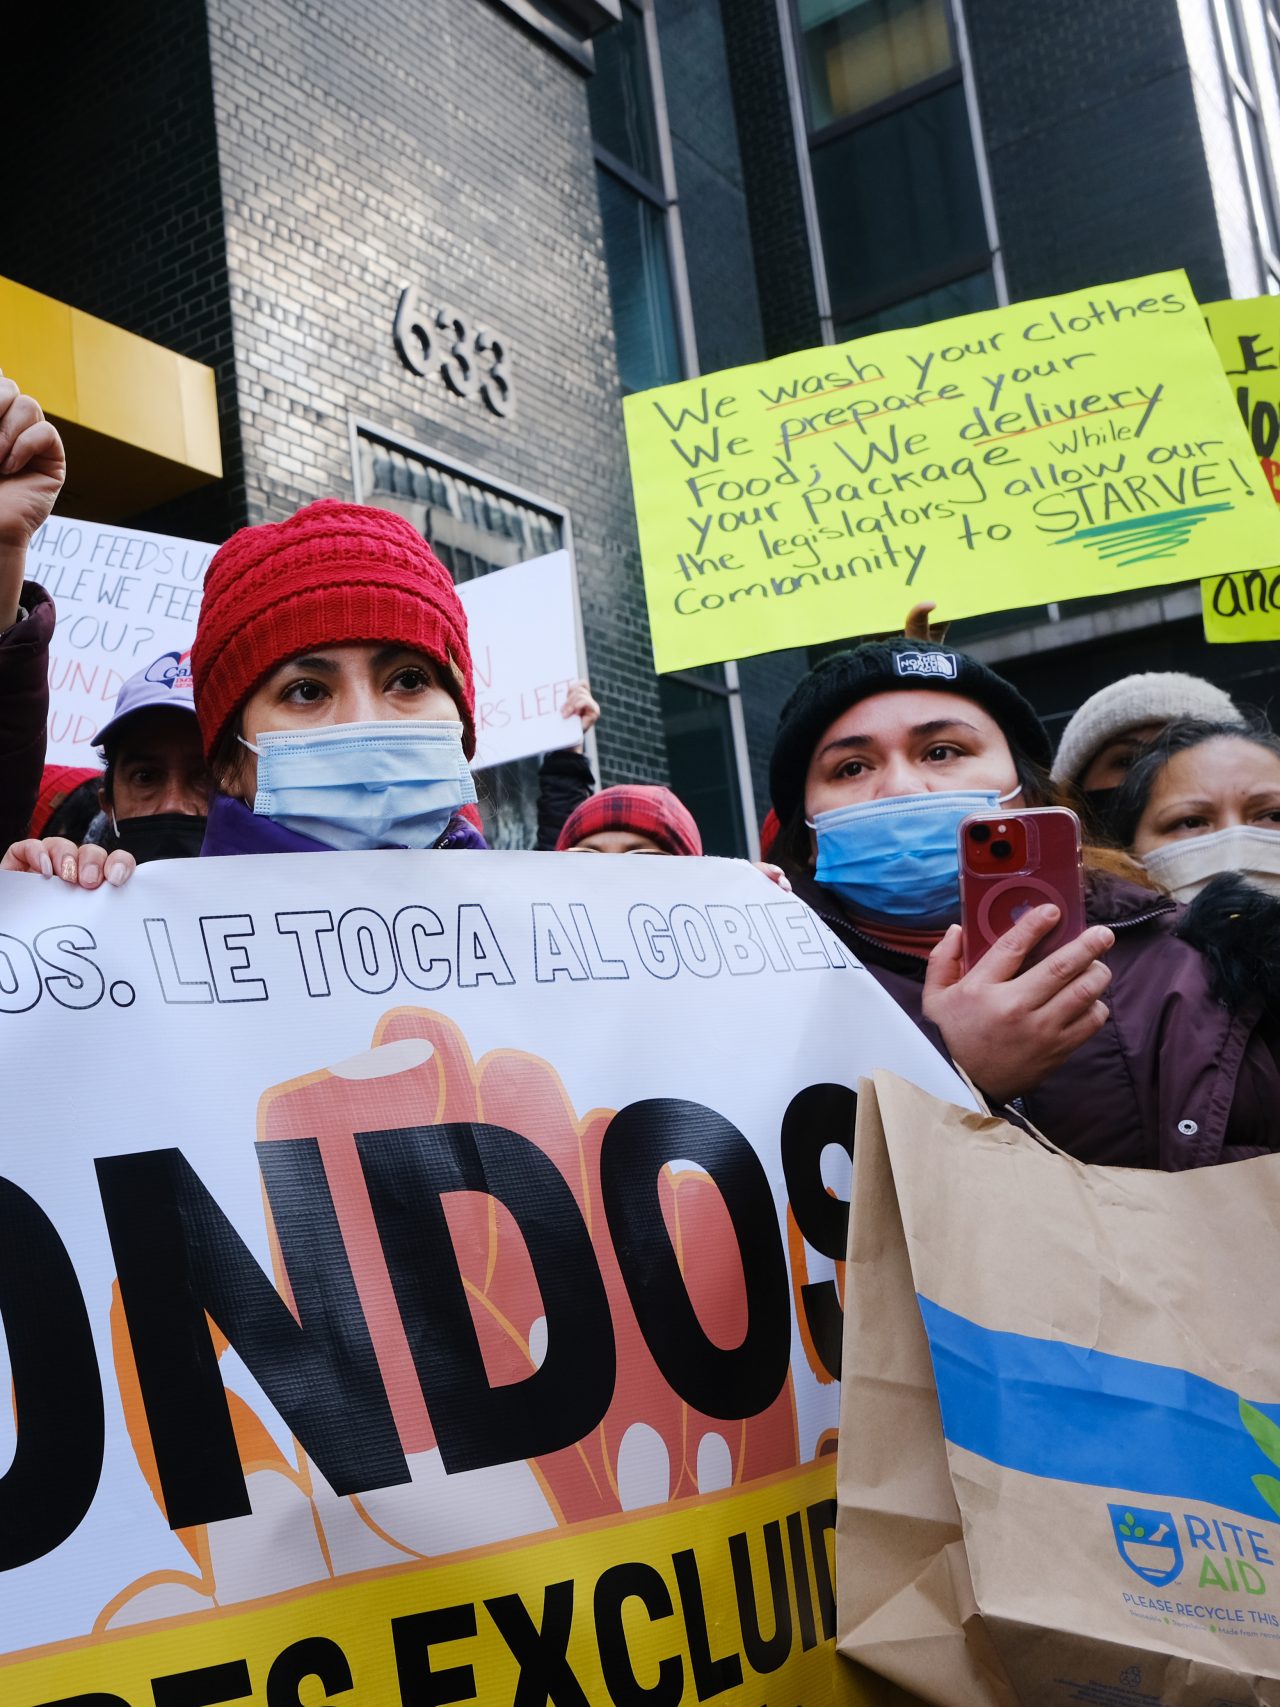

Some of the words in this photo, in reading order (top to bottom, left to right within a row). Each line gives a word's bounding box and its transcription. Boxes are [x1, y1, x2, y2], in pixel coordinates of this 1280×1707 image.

[392, 274, 517, 420] 633
[652, 387, 737, 432] We
[758, 355, 885, 405] wash
[906, 332, 1006, 391] your
[1022, 293, 1186, 342] clothes
[670, 426, 754, 469] We
[780, 384, 965, 462] prepare
[982, 351, 1097, 412] your
[834, 424, 931, 474] We
[959, 384, 1164, 439] delivery
[673, 552, 745, 582] the
[759, 500, 956, 569] legislators
[1004, 453, 1126, 497] allow
[1147, 440, 1224, 465] our
[687, 500, 782, 555] your
[801, 446, 1021, 525] package
[957, 513, 1012, 551] to
[1032, 458, 1256, 533] STARVE!
[89, 533, 176, 574] FEEDS
[181, 549, 211, 582] U
[97, 572, 141, 611] WE
[146, 582, 205, 623] FEE
[48, 656, 127, 702] UND
[142, 913, 269, 1004] LE
[275, 902, 517, 999] TOCA
[531, 901, 630, 984] AL
[1183, 1513, 1275, 1567] RITE
[1198, 1554, 1266, 1596] AID
[1122, 1592, 1174, 1613] PLEASE
[1176, 1602, 1245, 1623] RECYCLE
[1247, 1610, 1280, 1628] THIS
